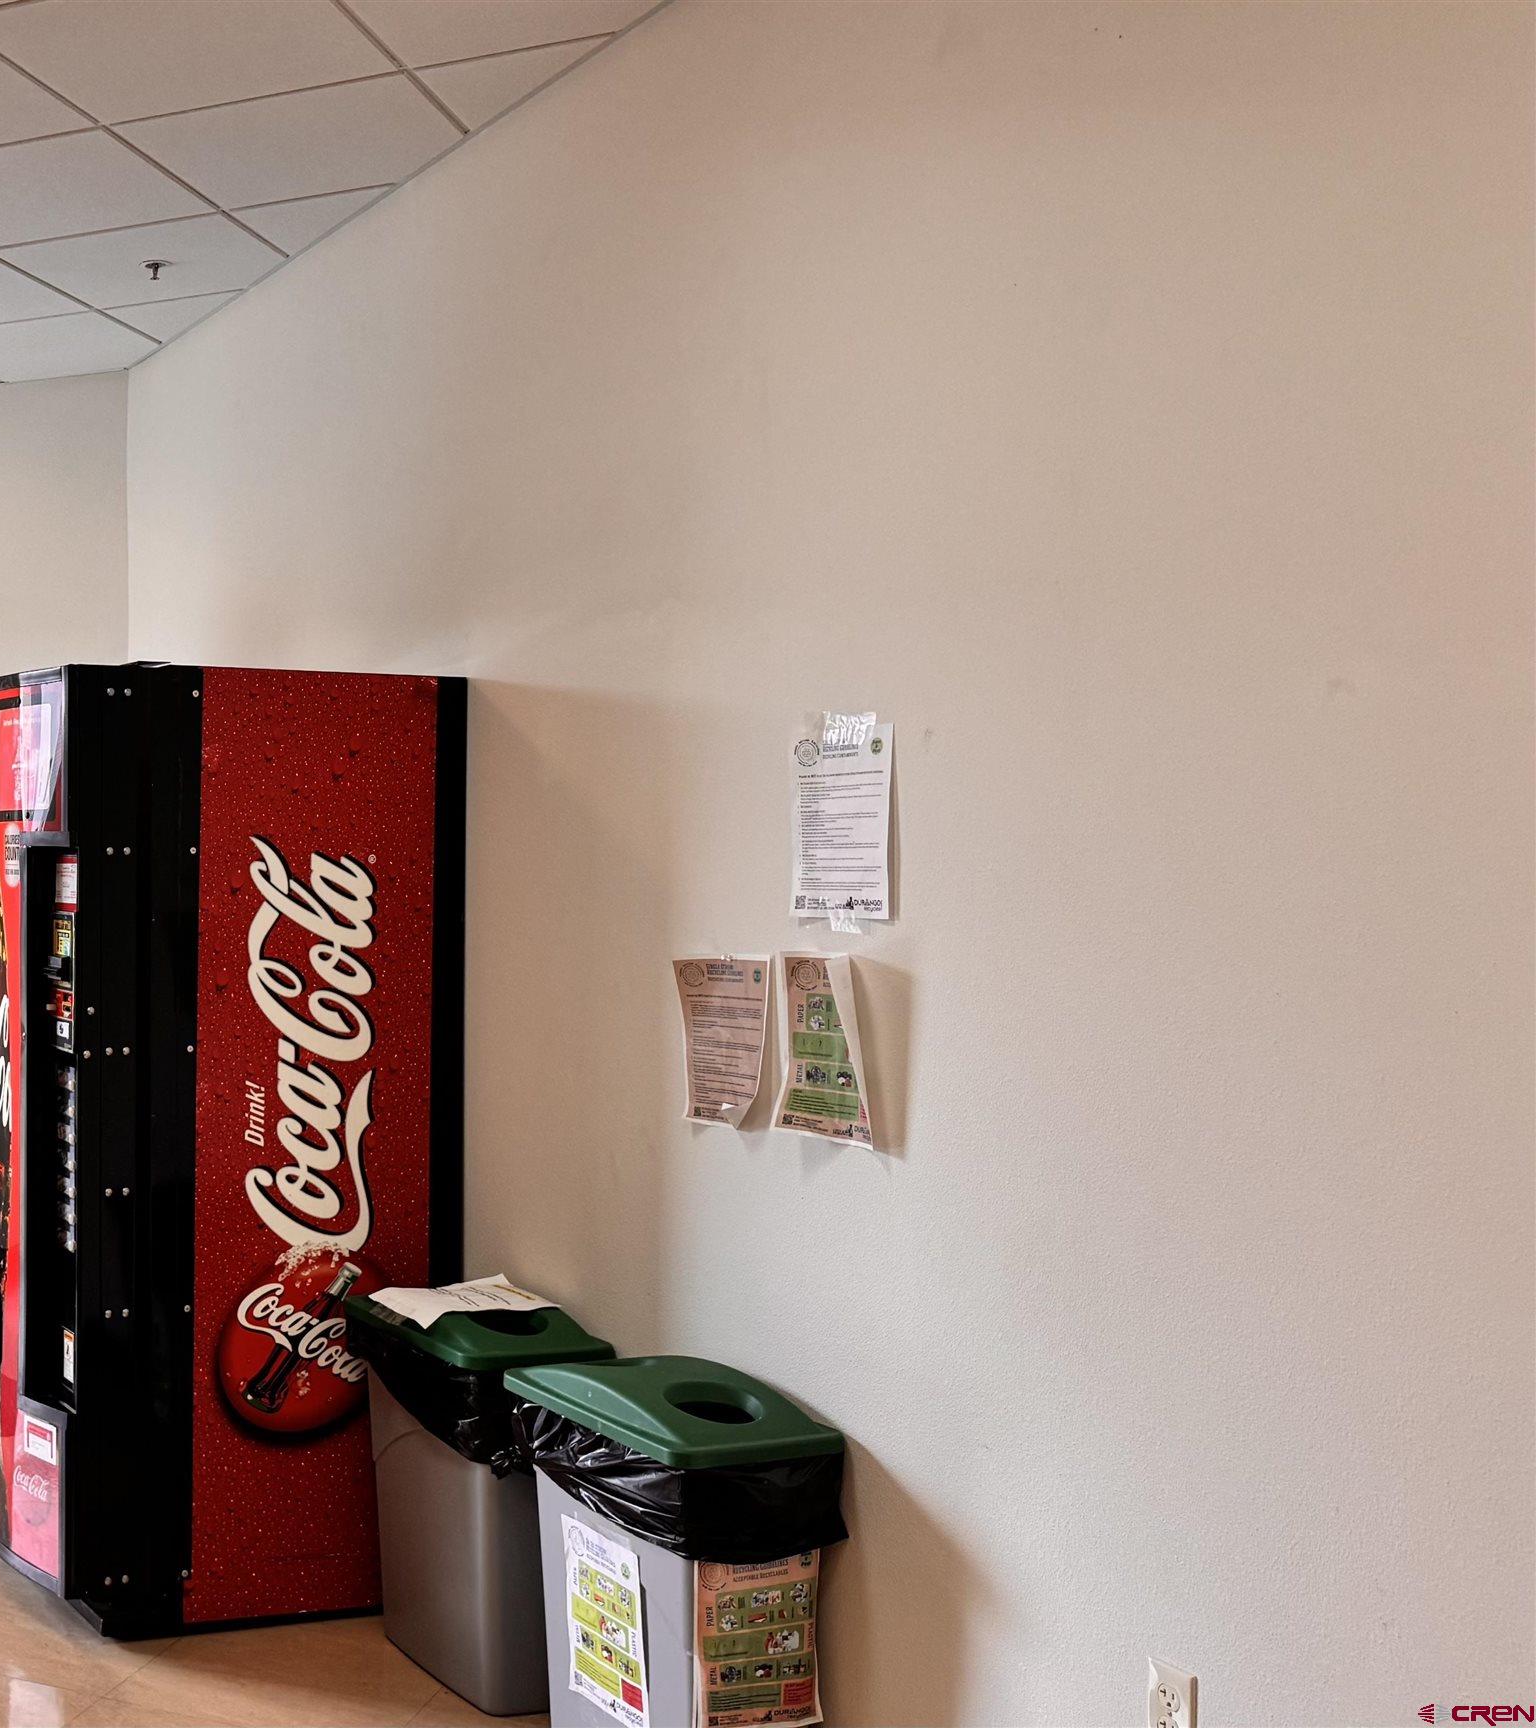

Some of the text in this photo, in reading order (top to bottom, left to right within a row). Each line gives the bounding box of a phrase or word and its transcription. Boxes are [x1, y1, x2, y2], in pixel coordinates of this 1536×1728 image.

[797, 1003, 805, 1023] PAPER
[245, 833, 376, 1256] Coca-Cola
[796, 1063, 804, 1083] METAL
[244, 1080, 265, 1147] Drink!
[13, 1465, 50, 1502] Coca-Cola
[705, 1606, 715, 1627] PAPER
[709, 1666, 718, 1686] METAL
